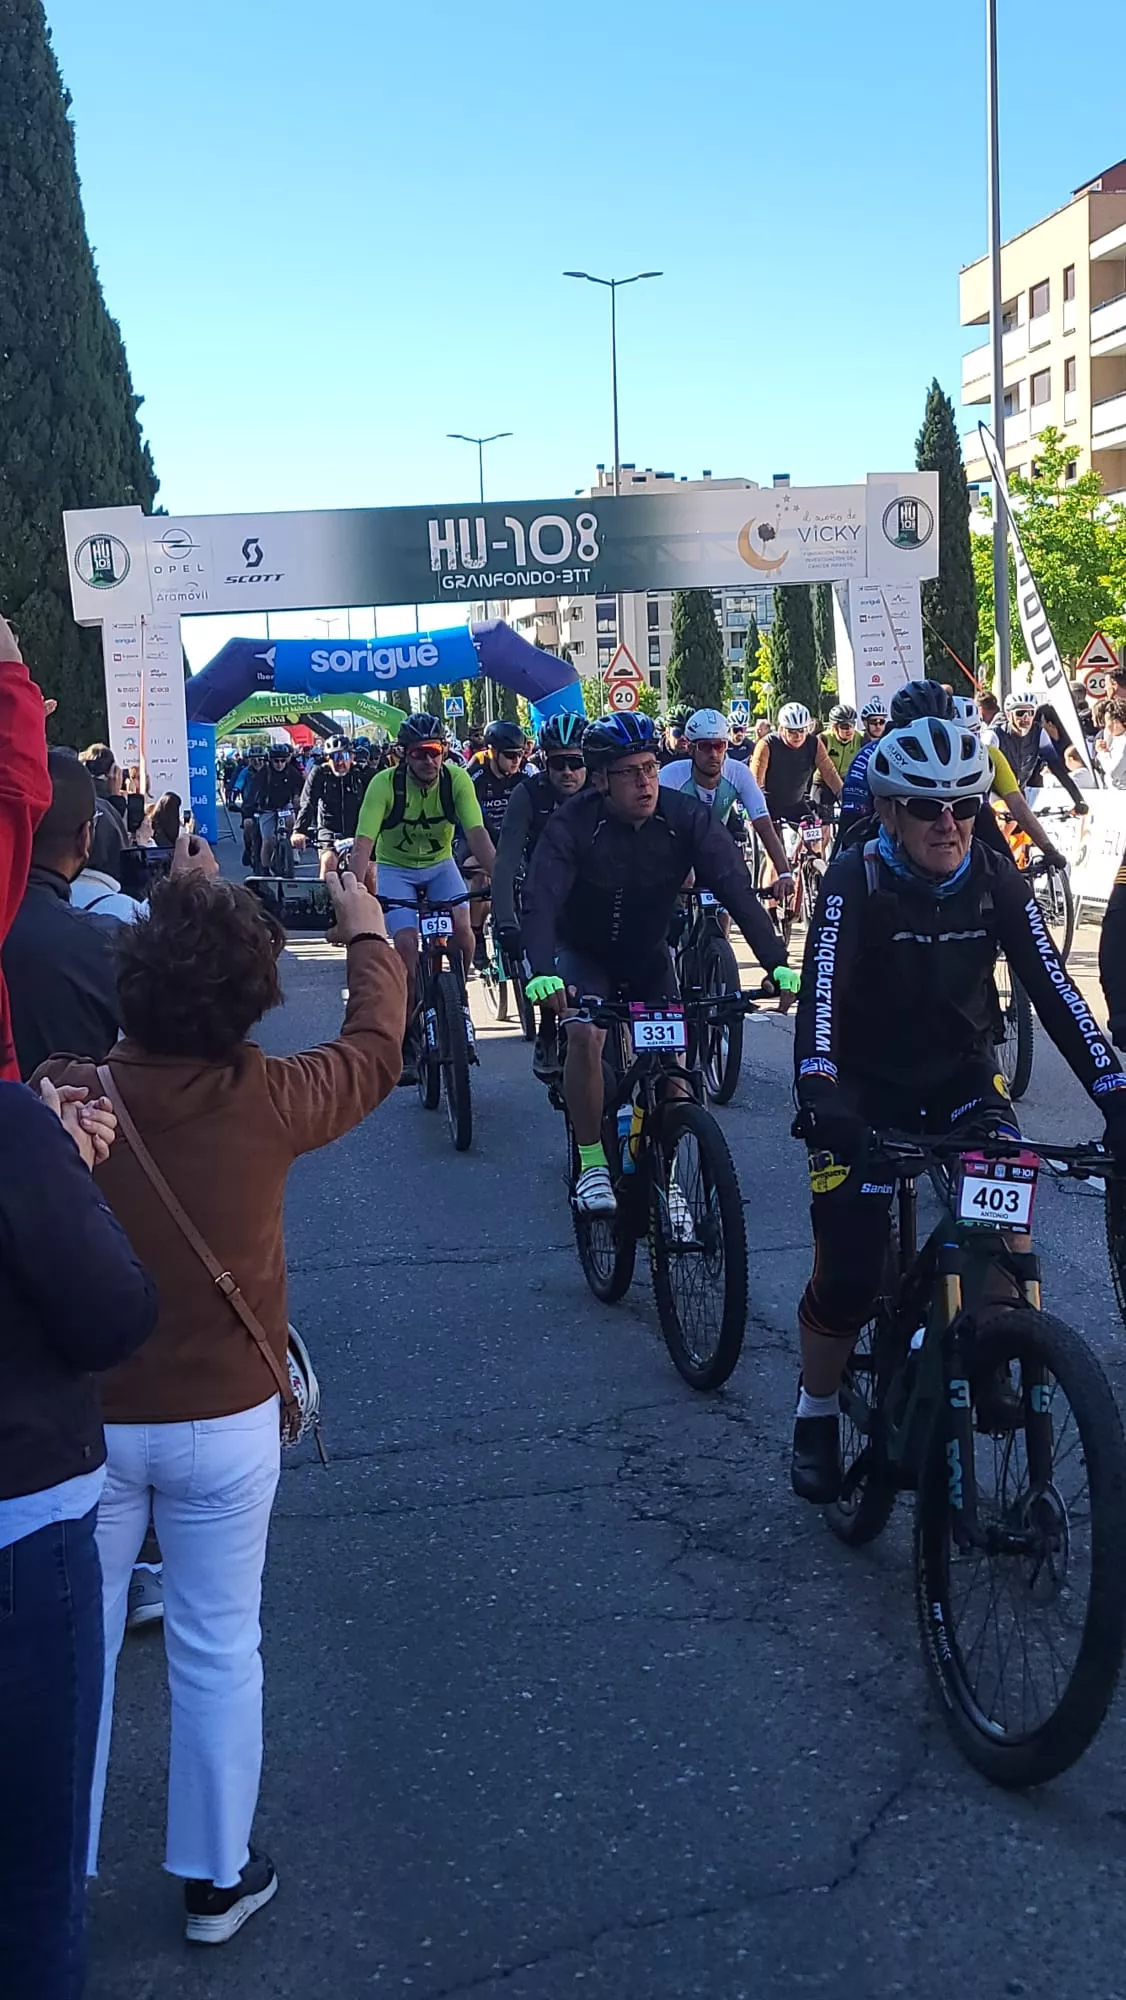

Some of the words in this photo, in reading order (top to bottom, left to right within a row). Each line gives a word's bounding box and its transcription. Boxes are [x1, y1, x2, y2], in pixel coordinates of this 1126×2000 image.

[427, 512, 600, 572] HU-108
[153, 564, 205, 574] OPEL
[224, 573, 285, 584] SCOTT
[615, 692, 633, 703] 20
[426, 919, 448, 931] 619
[813, 894, 844, 1052] www.zonabici.es
[1024, 898, 1111, 1069] www.zonabici.es
[642, 1025, 675, 1041] 331
[972, 1186, 1020, 1213] 403
